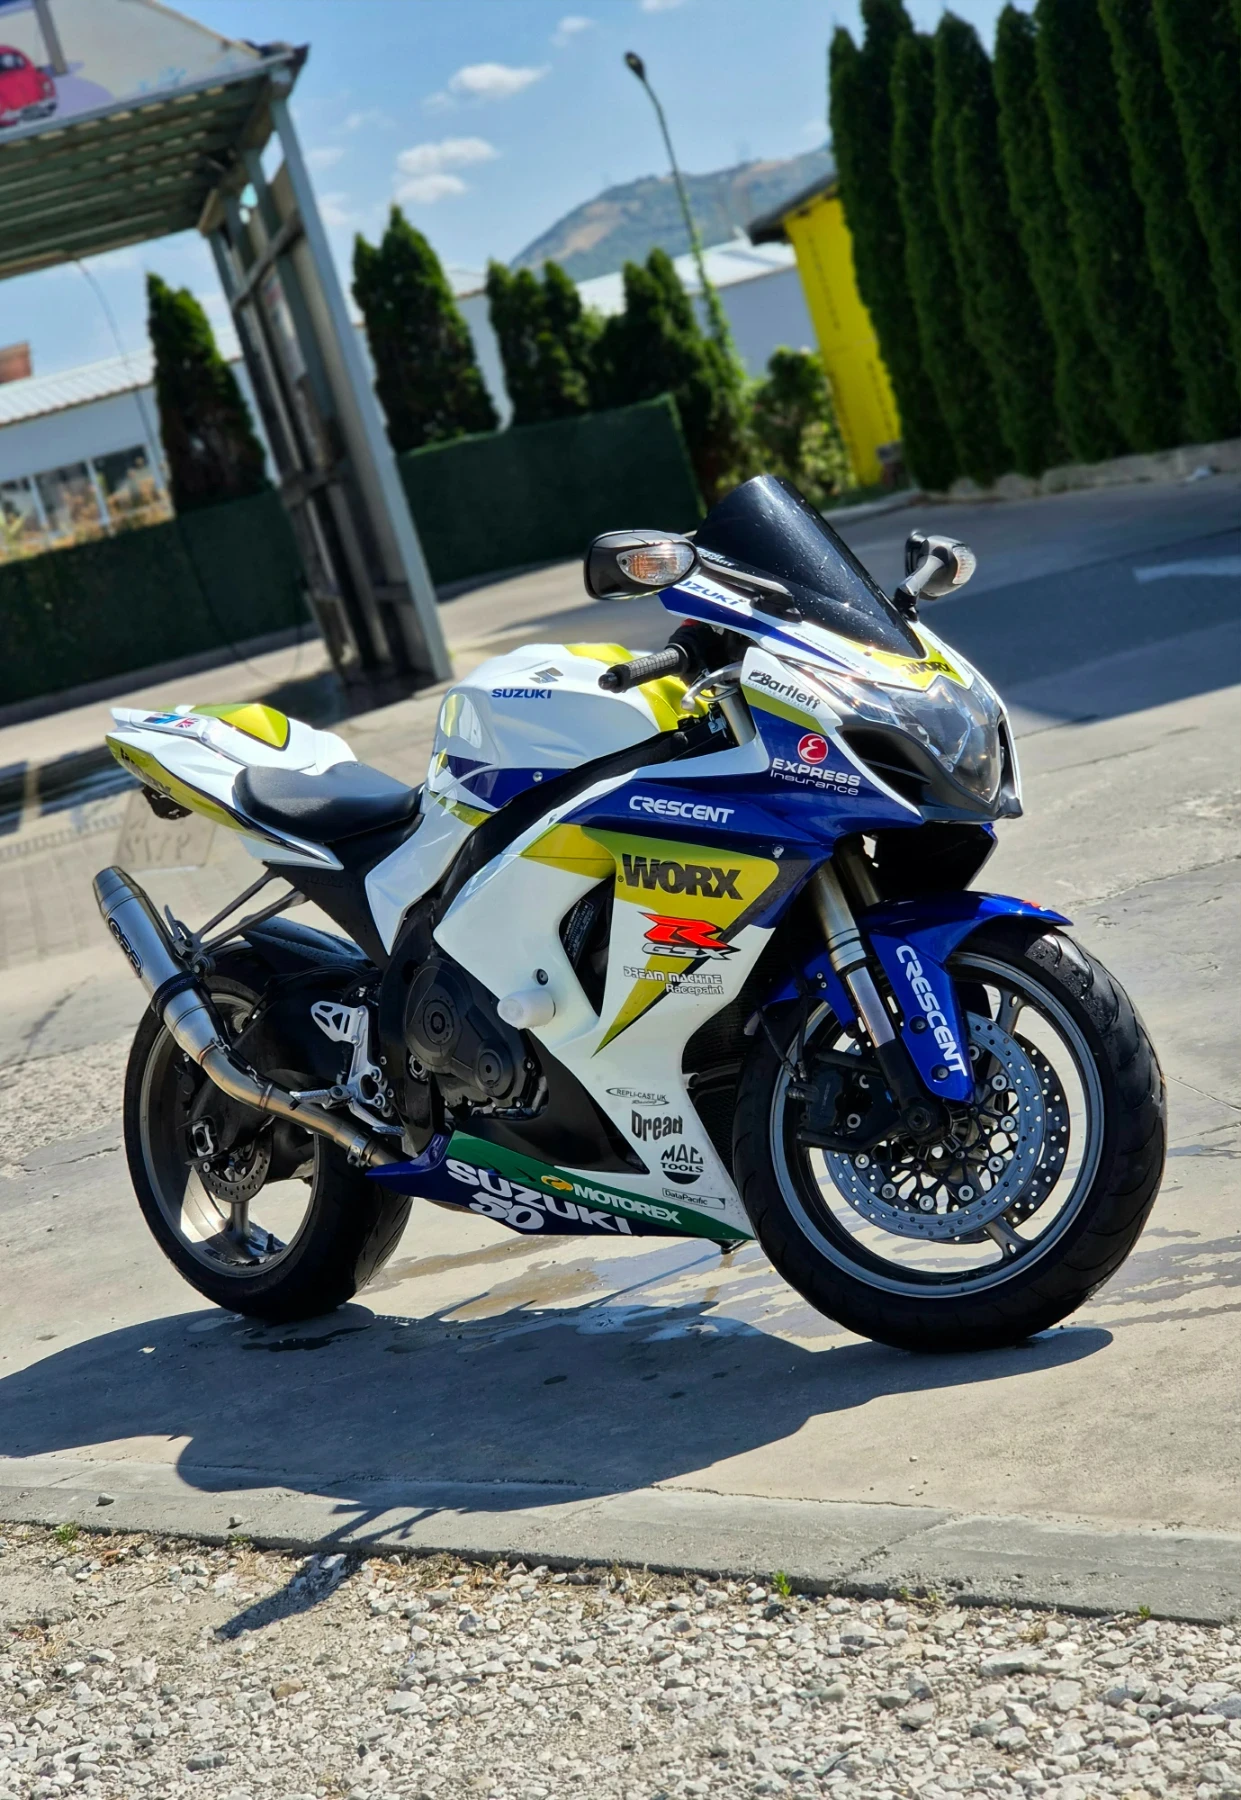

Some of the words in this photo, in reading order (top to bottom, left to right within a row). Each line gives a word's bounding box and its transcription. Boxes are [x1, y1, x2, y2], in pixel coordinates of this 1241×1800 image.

[491, 688, 552, 699] SUZUKI
[759, 673, 821, 710] Bartlett
[770, 769, 859, 796] Insurance
[772, 757, 861, 787] EXPRESS
[629, 795, 735, 824] CRESCENT
[622, 853, 744, 900] WORX
[642, 942, 732, 960] GSX
[623, 966, 665, 981] DREAM
[665, 983, 724, 996] Racepaint
[896, 945, 968, 1077] CRESCENT
[631, 1109, 683, 1142] Dread
[660, 1162, 704, 1173] TOOLS
[661, 1144, 704, 1164] MAC
[445, 1159, 633, 1235] SUZUKI
[572, 1183, 682, 1225] MOTOREX
